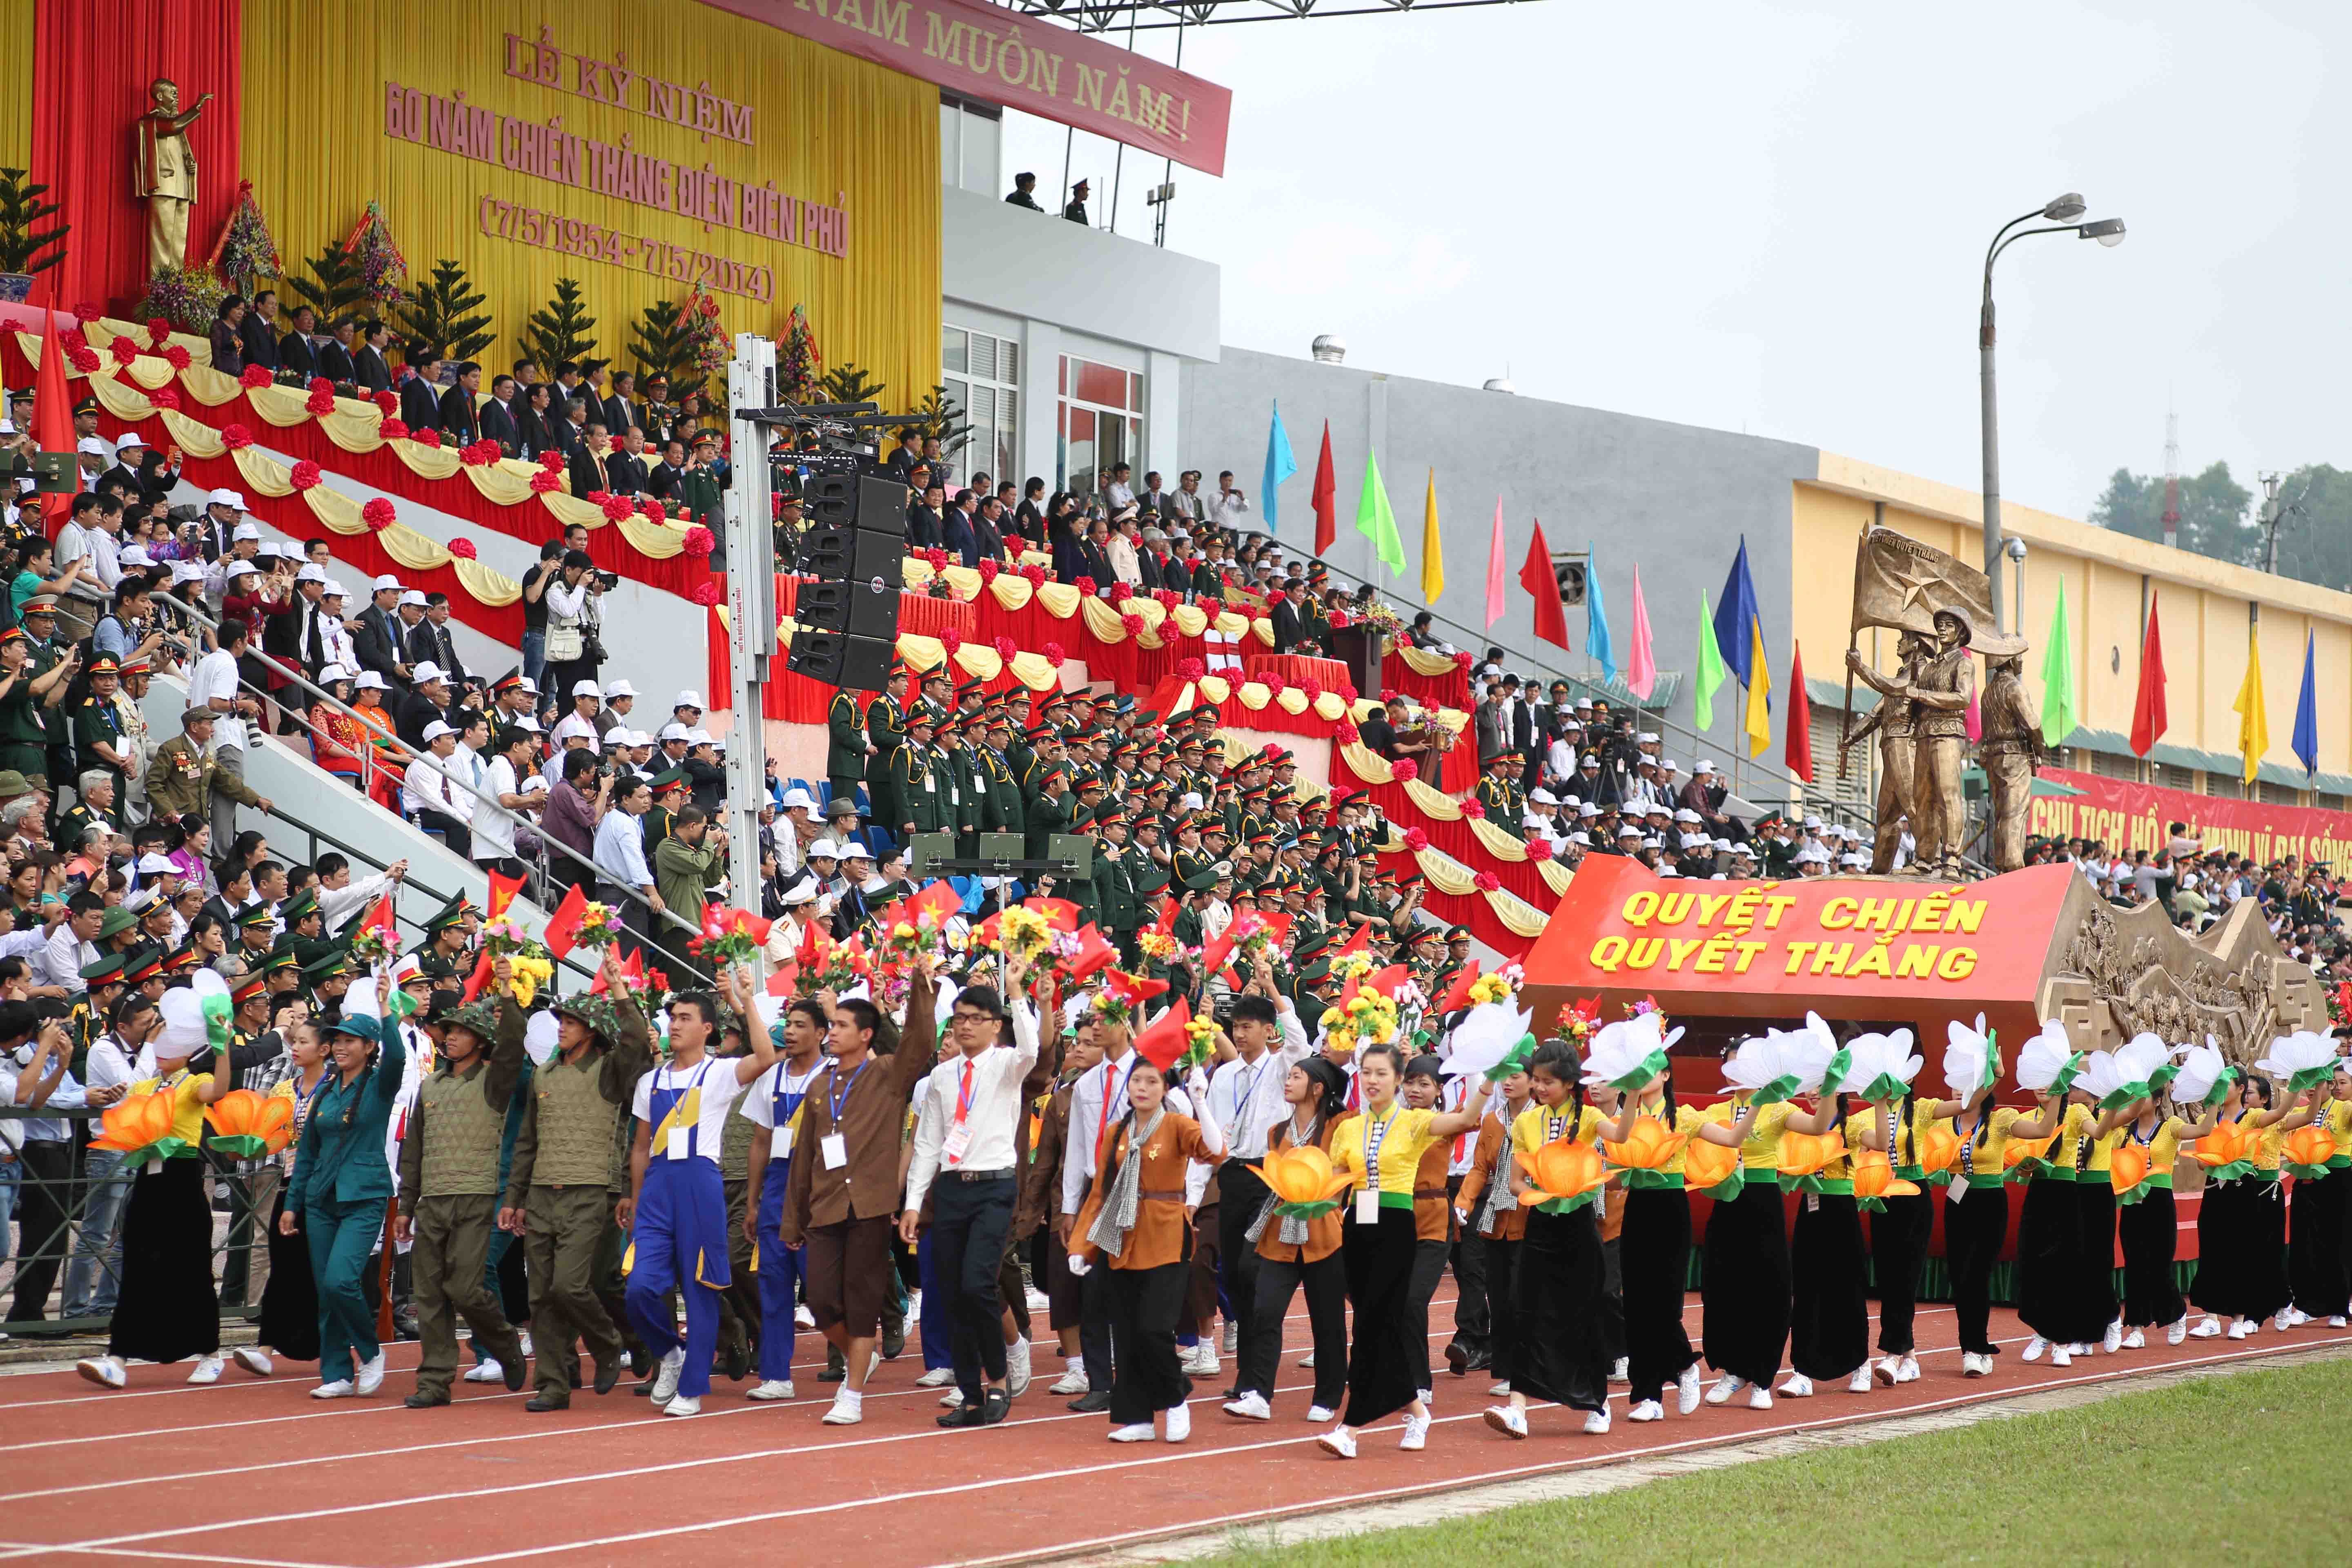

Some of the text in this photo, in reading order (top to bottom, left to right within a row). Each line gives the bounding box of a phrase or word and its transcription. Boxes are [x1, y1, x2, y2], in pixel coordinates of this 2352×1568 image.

[503, 24, 754, 146] LỄ KỶ NIỆM
[922, 10, 1064, 97] MUÔN
[386, 81, 849, 258] 60 NĂM CHIẾN THẮNG ĐIỆN BIÊN PHỦ
[2130, 802, 2160, 860] HỒ
[2202, 825, 2250, 862] MINH
[2254, 825, 2274, 867] VĨ
[1621, 881, 1989, 934] QUYẾT CHIẾN
[1590, 926, 1978, 980] QUYẾT THẮNG
